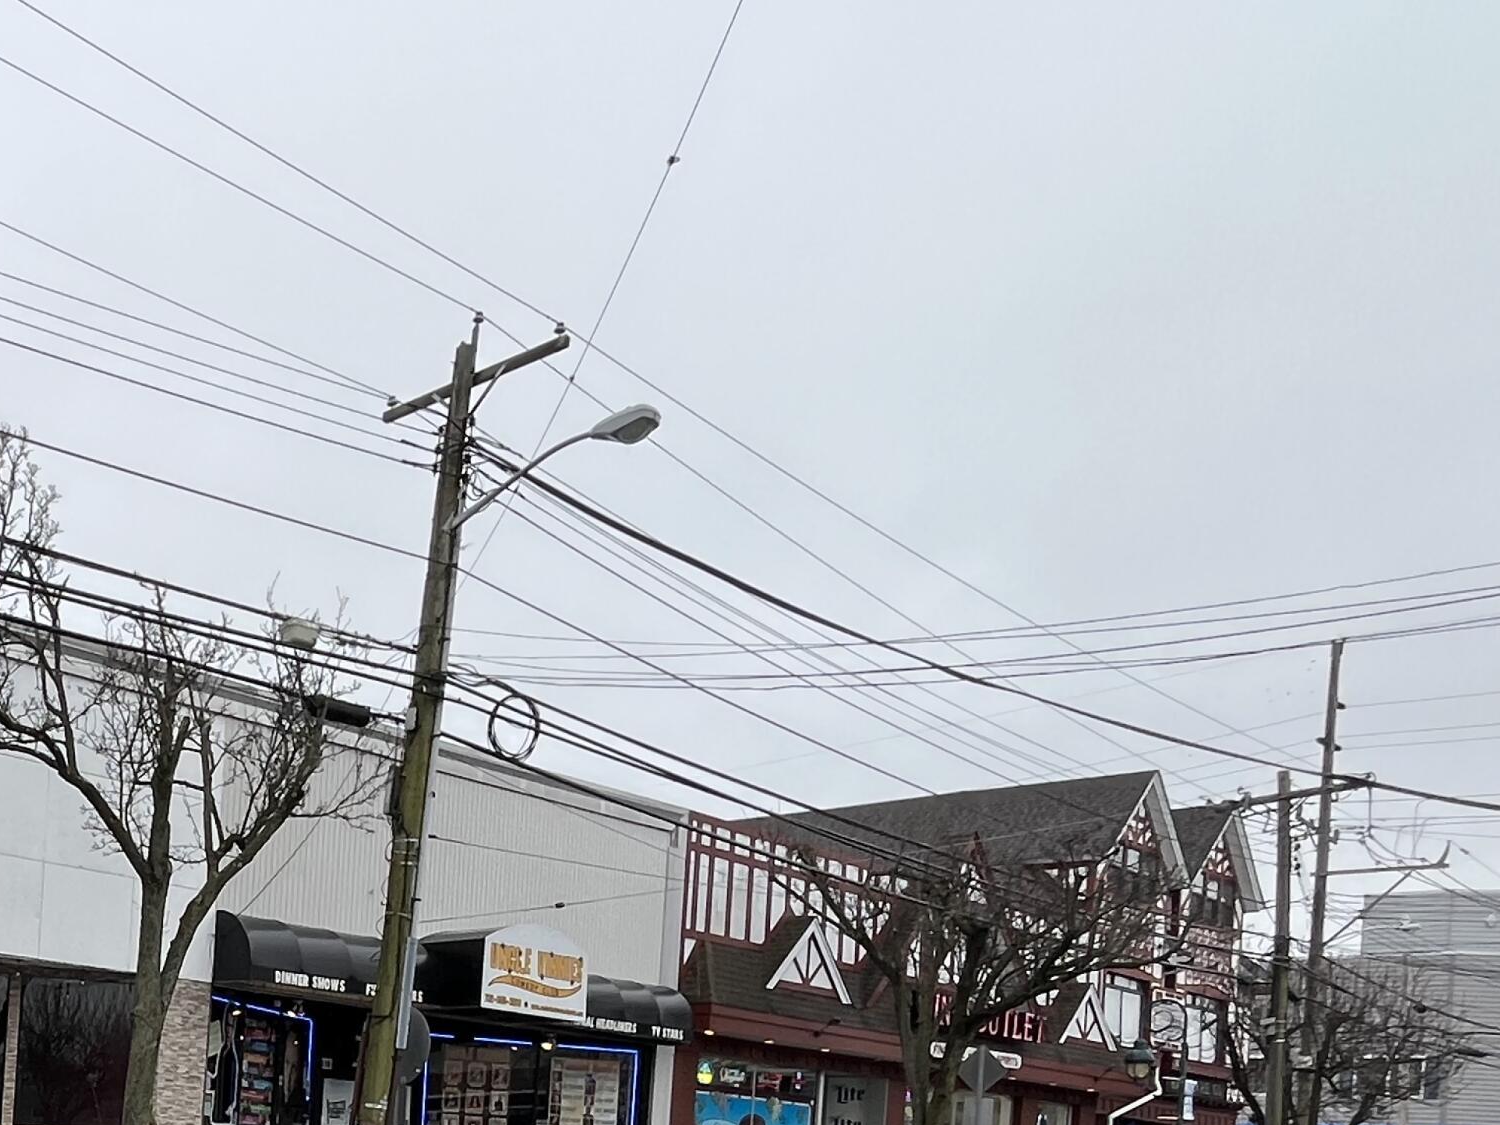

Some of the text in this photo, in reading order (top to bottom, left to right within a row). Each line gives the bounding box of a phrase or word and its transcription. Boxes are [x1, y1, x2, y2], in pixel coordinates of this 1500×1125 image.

[275, 970, 346, 992] DINNER SHOWS
[651, 1025, 684, 1041] TV STARS
[978, 1009, 1047, 1044] UTLET
[834, 1084, 865, 1104] Lite
